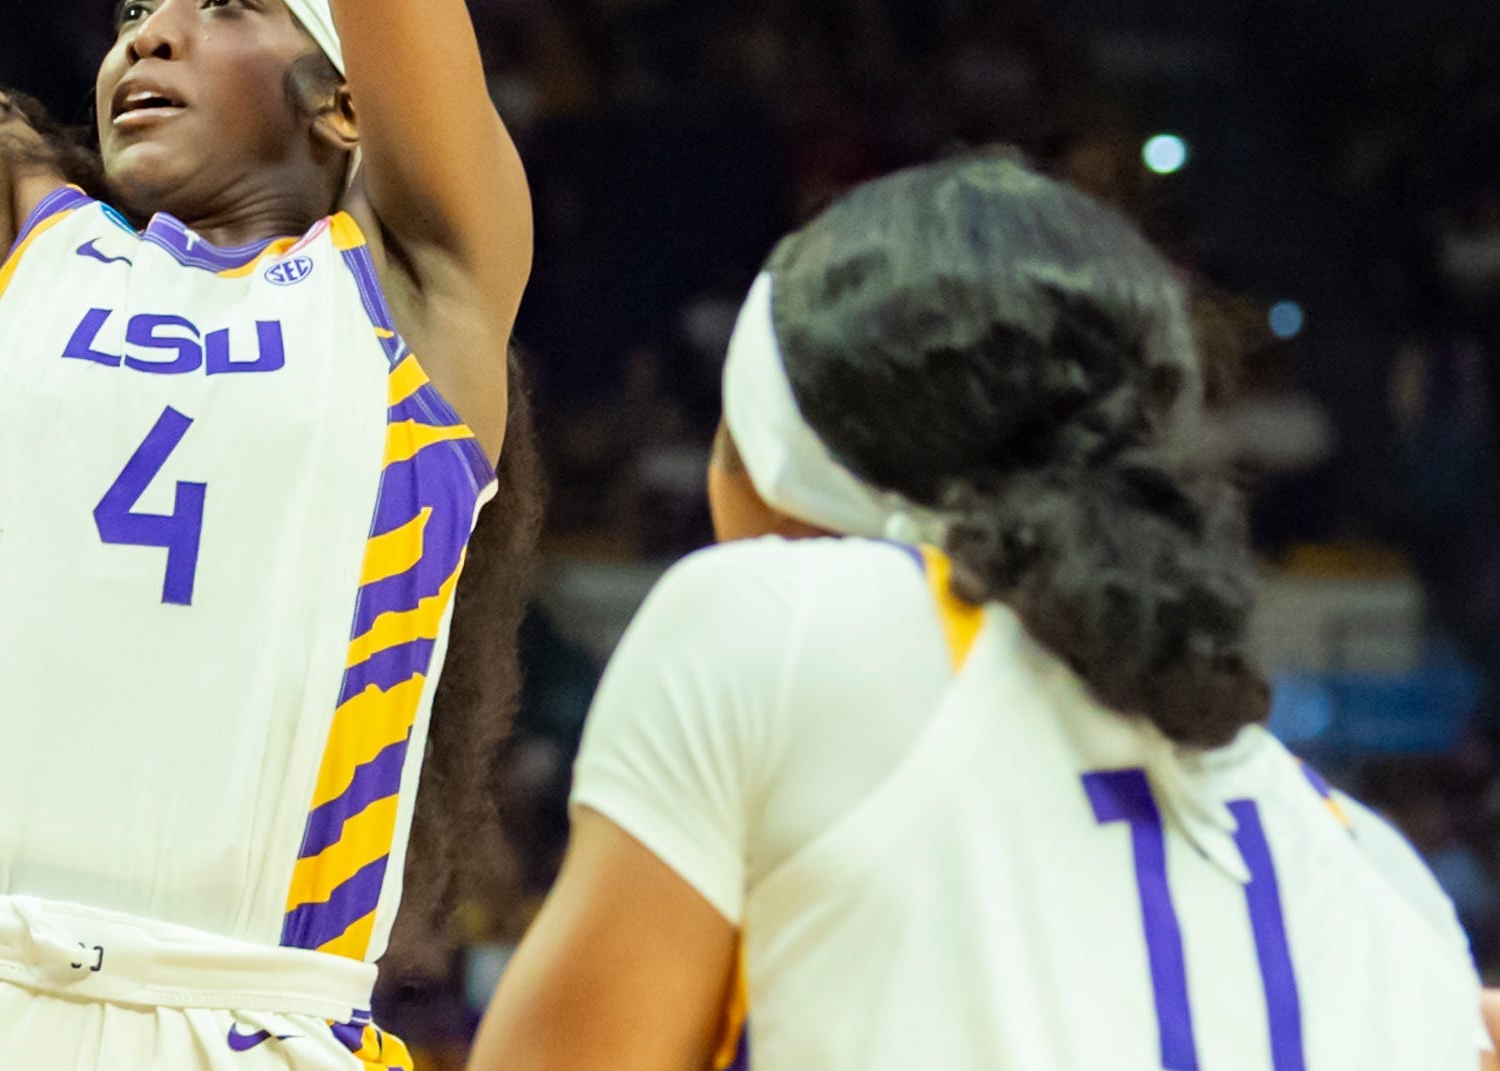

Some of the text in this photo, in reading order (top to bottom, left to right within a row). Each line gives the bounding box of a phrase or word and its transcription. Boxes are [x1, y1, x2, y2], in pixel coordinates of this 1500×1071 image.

[269, 258, 309, 282] SEC
[62, 307, 286, 376] LSU
[93, 404, 208, 606] 4
[1080, 766, 1308, 1071] 11
